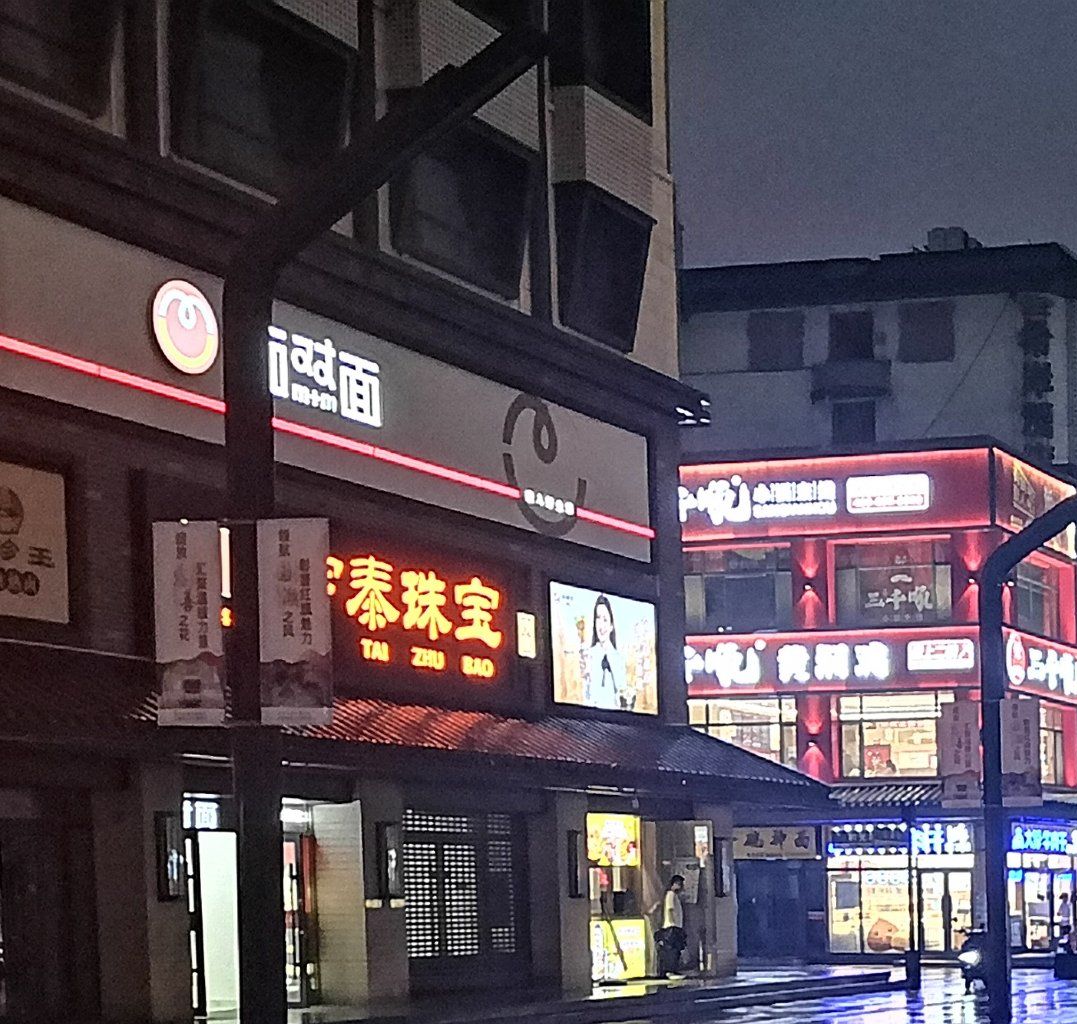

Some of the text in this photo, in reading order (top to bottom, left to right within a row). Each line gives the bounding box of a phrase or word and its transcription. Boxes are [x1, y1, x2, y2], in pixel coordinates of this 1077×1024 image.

[360, 637, 495, 679] TAI ZHU BAO
